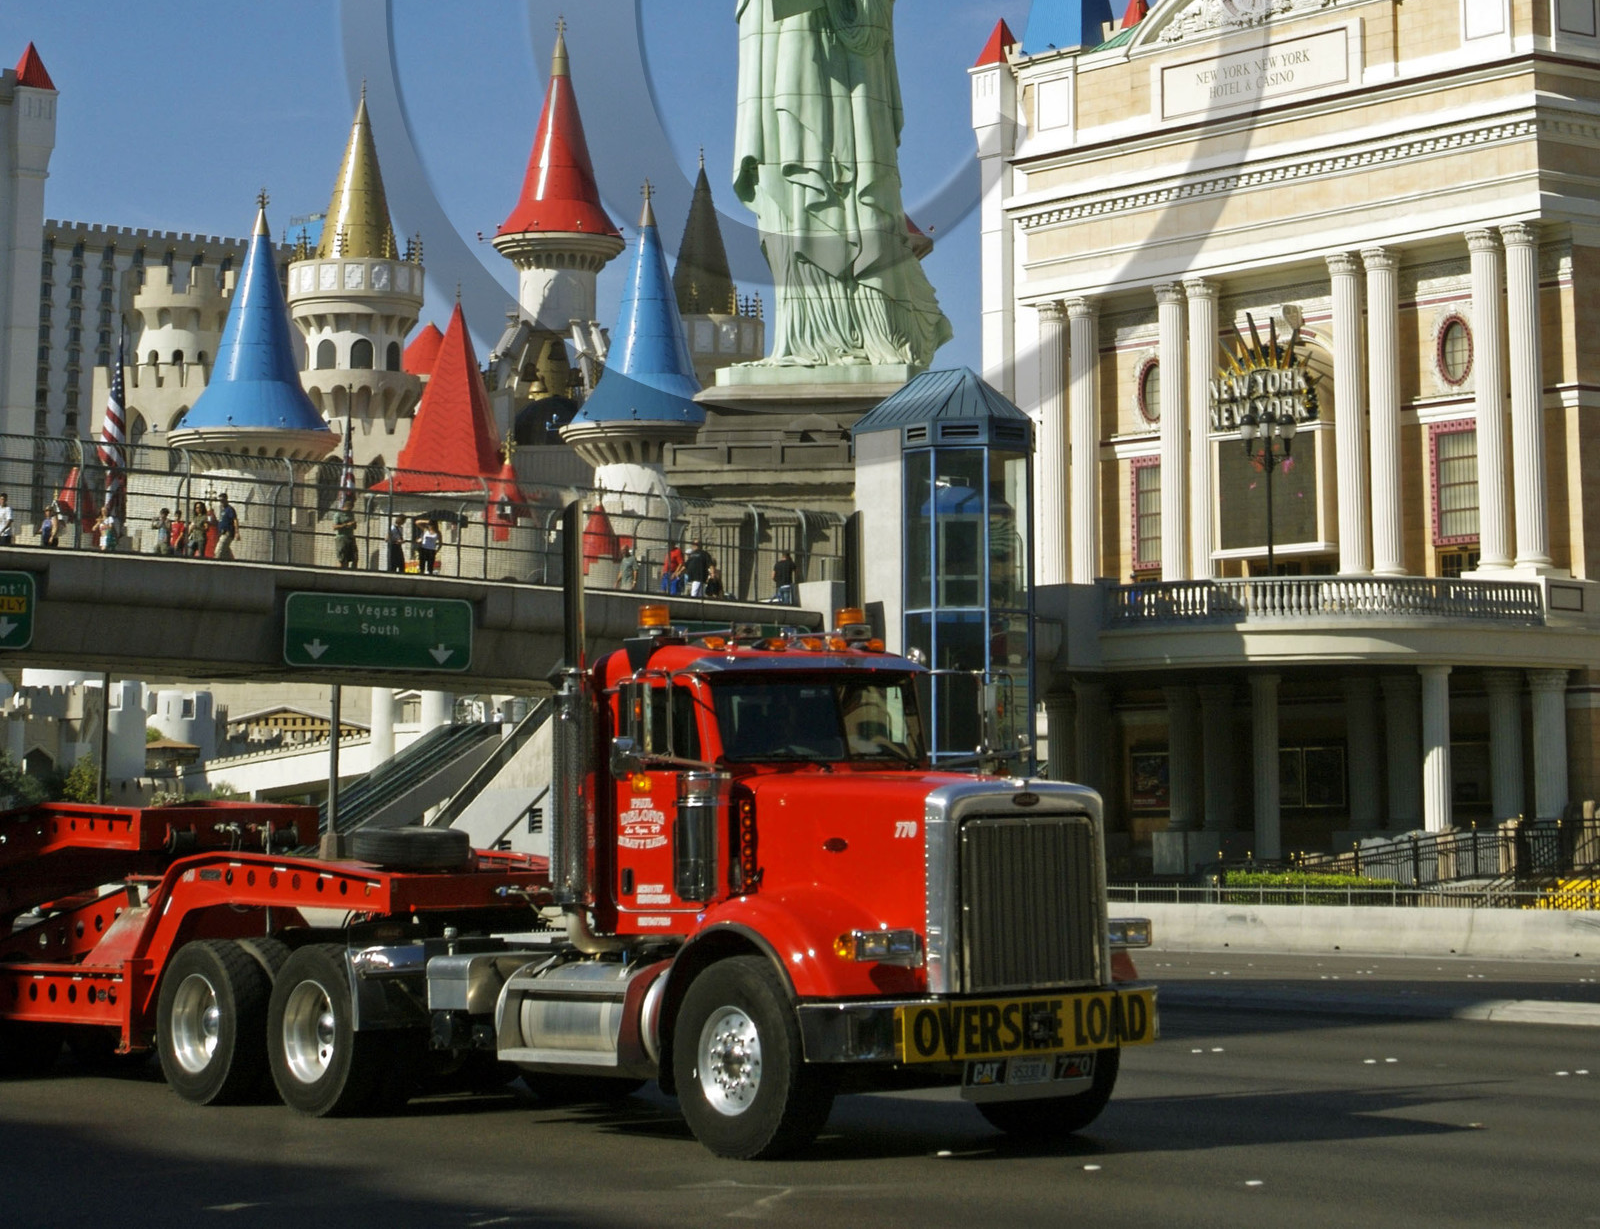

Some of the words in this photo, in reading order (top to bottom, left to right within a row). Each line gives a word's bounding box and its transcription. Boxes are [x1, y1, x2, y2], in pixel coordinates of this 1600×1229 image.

[1196, 69, 1219, 85] NEW
[1222, 63, 1251, 80] YORK
[1254, 55, 1278, 73] NEW
[1281, 48, 1311, 67] YORK
[1210, 81, 1241, 99] HOTEL
[1245, 82, 1252, 92] &
[1256, 69, 1294, 89] CASINO
[1209, 375, 1249, 399] NEW
[1253, 369, 1307, 394] YORK
[1209, 400, 1250, 427] NEW
[327, 602, 349, 615] Las
[357, 604, 397, 619] Vegas
[404, 606, 434, 618] Blvd
[361, 623, 399, 635] South
[894, 821, 917, 838] 770
[1075, 994, 1146, 1046] LOAD
[973, 1062, 1000, 1082] CAT
[1058, 1057, 1090, 1077] 770
